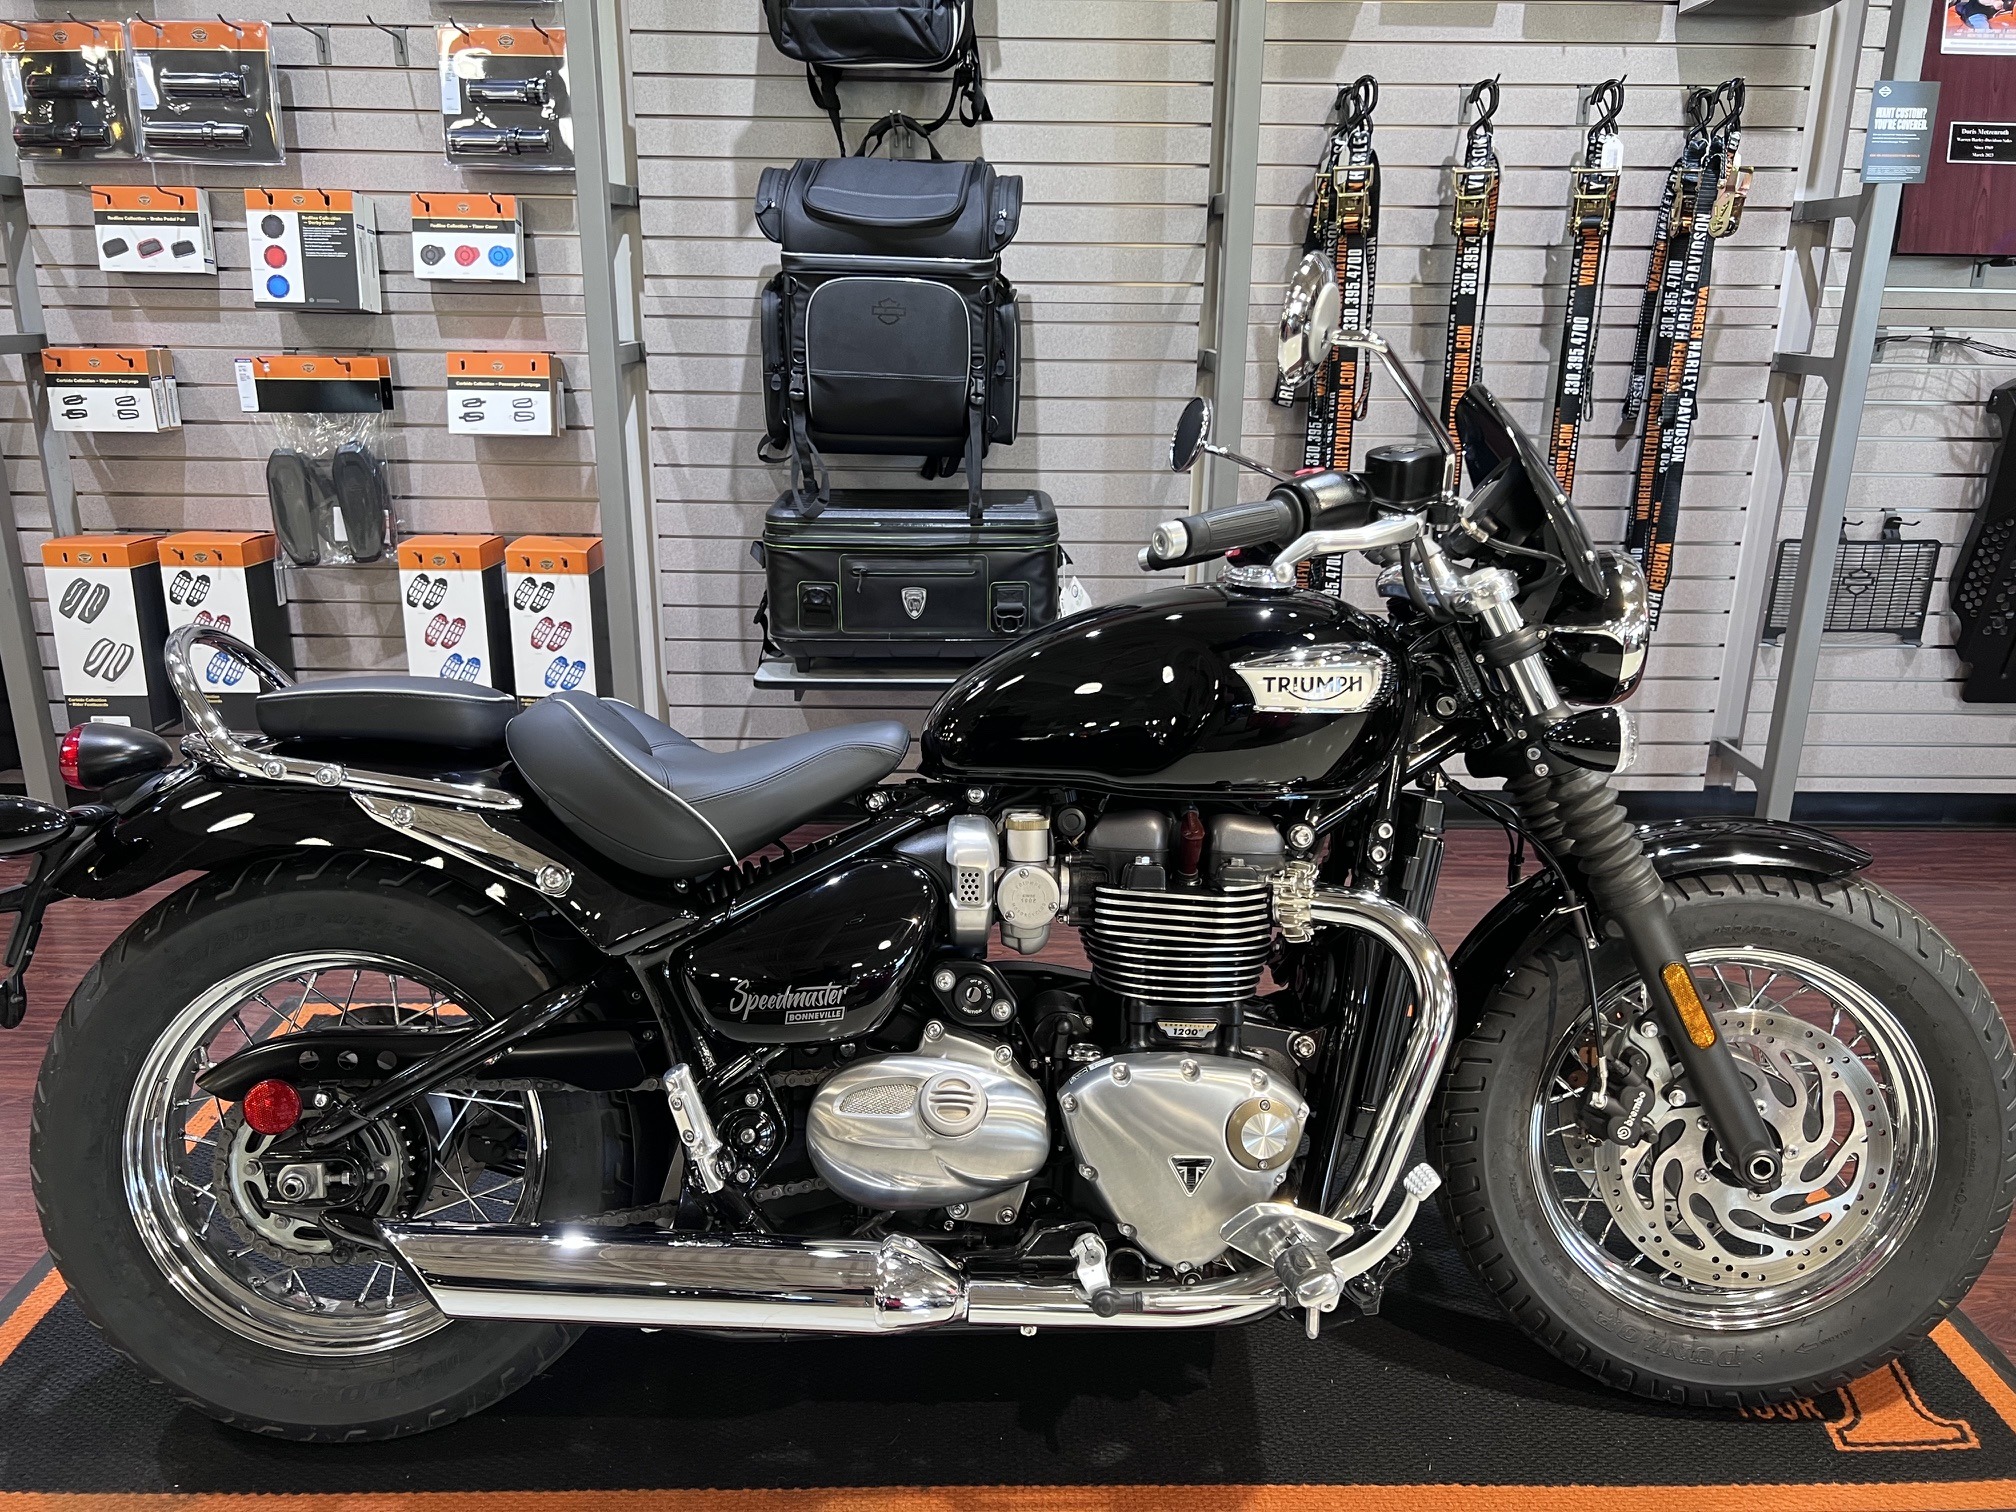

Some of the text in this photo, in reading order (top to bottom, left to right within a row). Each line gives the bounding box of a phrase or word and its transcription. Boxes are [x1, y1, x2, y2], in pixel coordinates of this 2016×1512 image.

[1875, 106, 1928, 119] WANT CUSTOM?
[1341, 248, 1363, 332] 330.395.4700
[1648, 240, 1668, 292] WARREN
[1659, 259, 1683, 338] 330.395.4700
[1666, 212, 1712, 394] WARREN HARLEY-DAVIDSON
[1564, 316, 1590, 396] 330.395.4700
[1670, 286, 1709, 463] WARREN HARLEY-DAVIDSON
[1650, 542, 1672, 592] WARREN
[1262, 675, 1363, 700] TRIUMPH
[729, 979, 849, 1022] Speedmaster
[788, 1009, 842, 1022] BONNEVILLE
[1173, 1028, 1198, 1036] 1200
[1623, 1091, 1647, 1128] brembo
